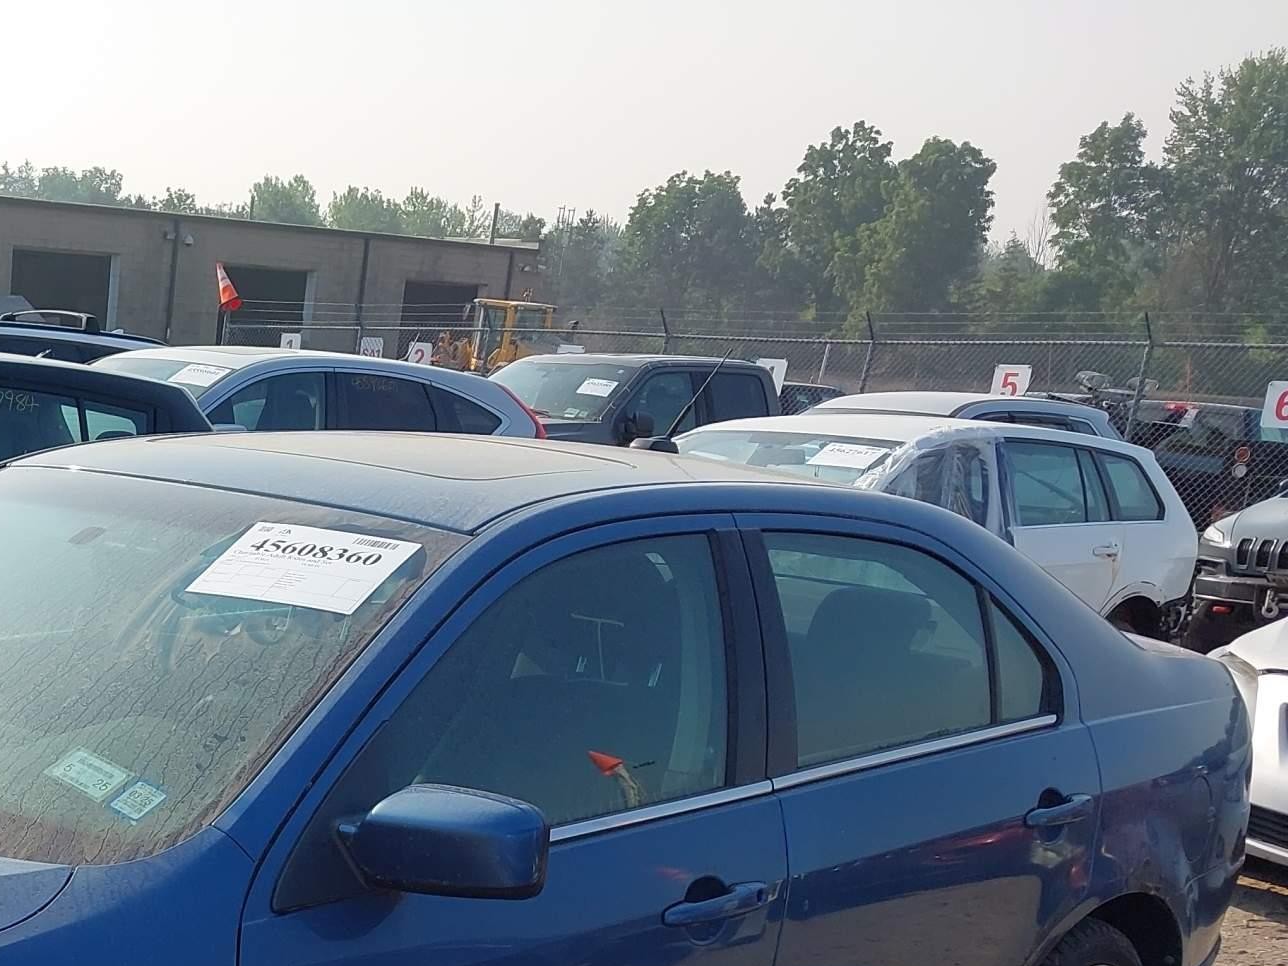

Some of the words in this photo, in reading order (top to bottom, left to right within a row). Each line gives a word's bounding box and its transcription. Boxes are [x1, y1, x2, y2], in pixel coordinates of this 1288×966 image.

[414, 348, 425, 363] 2
[1000, 372, 1019, 397] 5
[1275, 390, 1288, 421] 6
[250, 538, 383, 566] 45608360
[92, 778, 112, 792] 25
